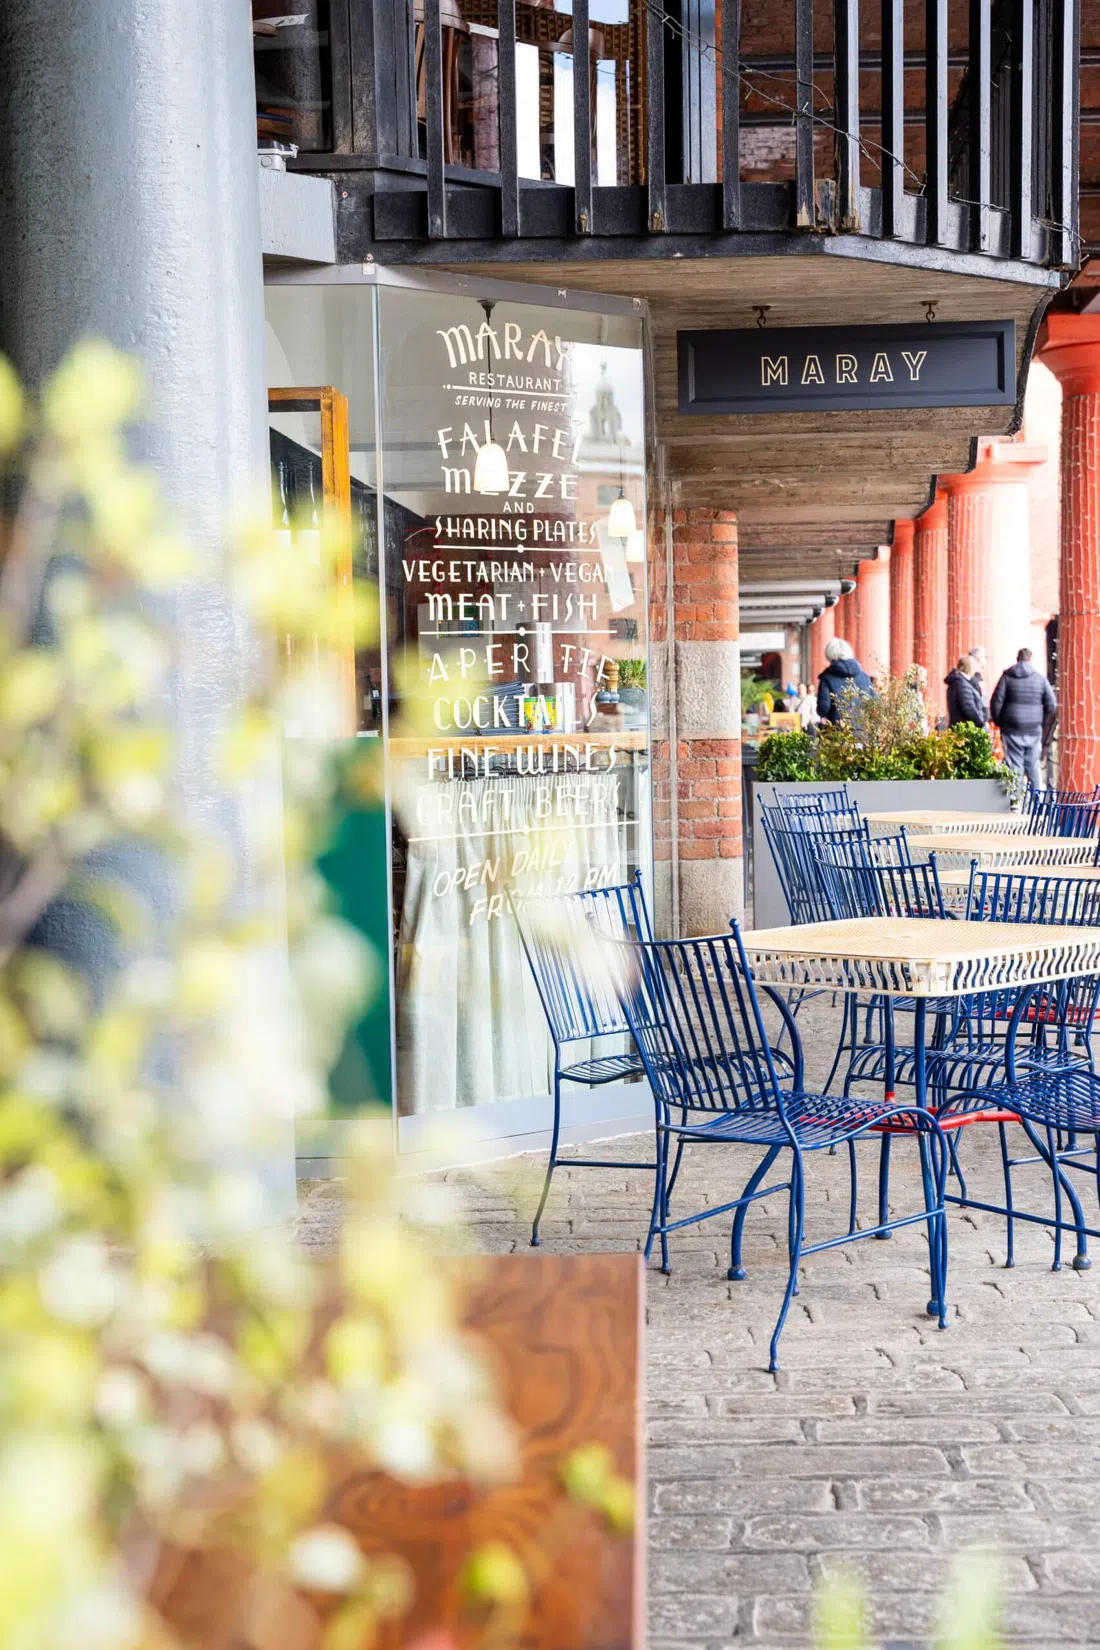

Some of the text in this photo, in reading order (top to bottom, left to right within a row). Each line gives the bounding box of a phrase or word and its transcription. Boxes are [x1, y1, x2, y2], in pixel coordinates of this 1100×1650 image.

[469, 372, 561, 391] RESTAURANT
[761, 351, 928, 386] MARAY
[454, 395, 568, 412] SERVING THE FINEST
[441, 466, 579, 500] MZZE
[503, 501, 535, 513] AND
[435, 515, 597, 544] SHARING PLATES
[402, 559, 534, 583] VEGETARIAN
[550, 561, 615, 583] VEGAN
[425, 592, 512, 621] MEAT
[531, 592, 598, 622] FISH
[427, 742, 617, 780] FINE WINES
[416, 781, 621, 827] CRAFT BEERS
[433, 838, 575, 897] OPEN DAILY
[583, 864, 618, 892] PM
